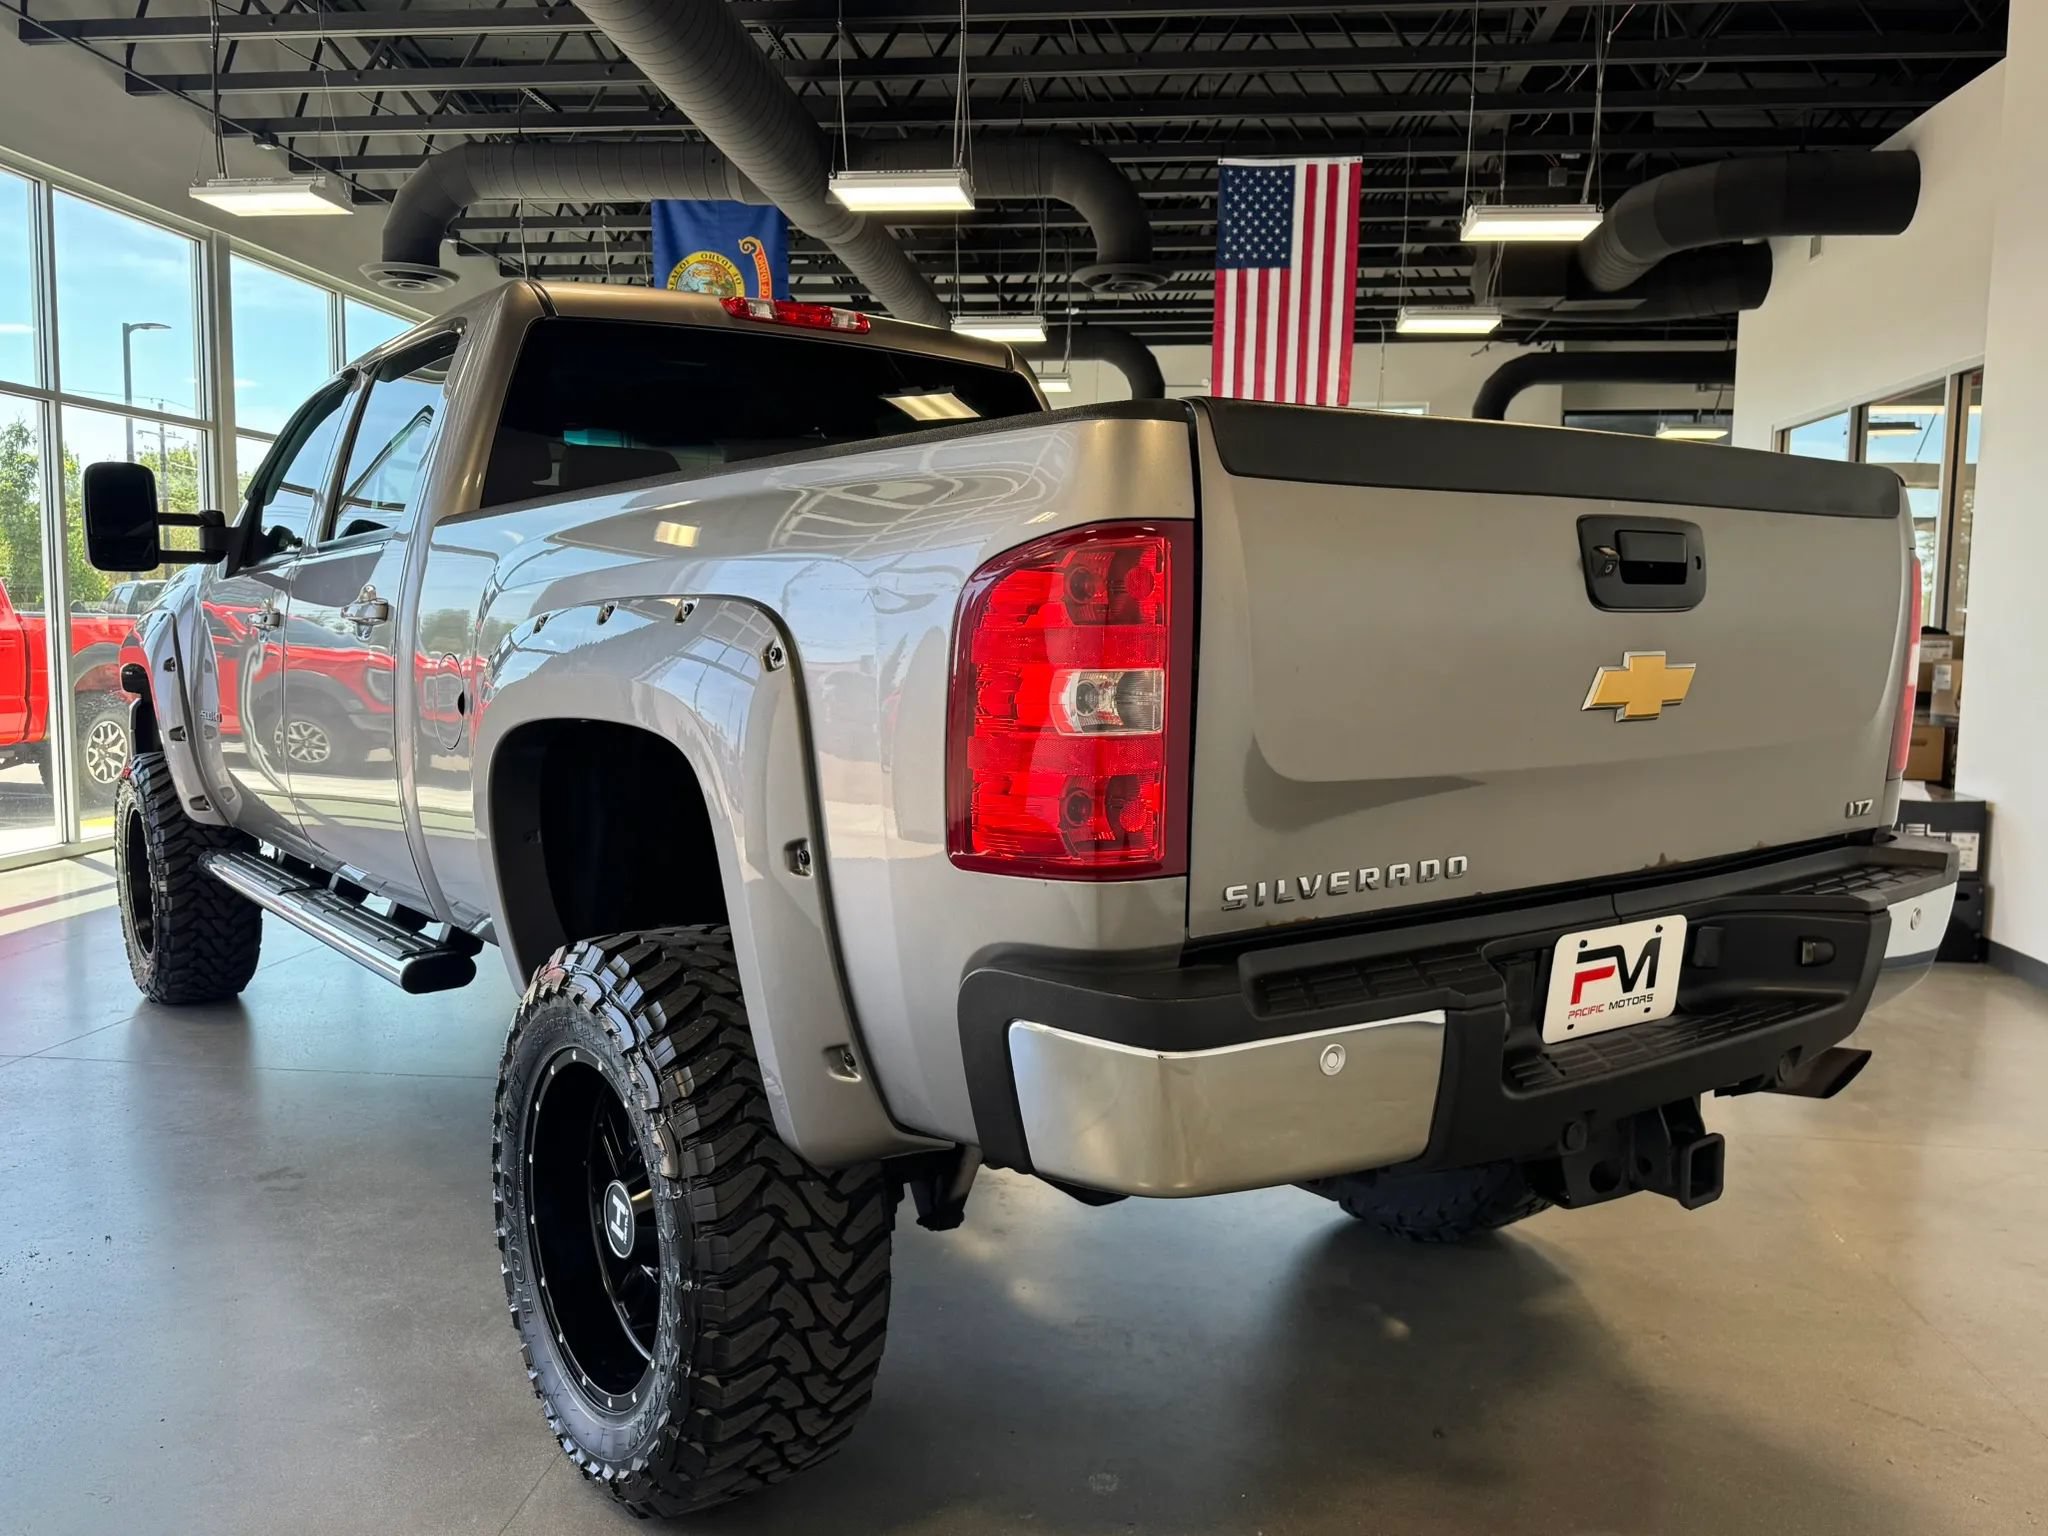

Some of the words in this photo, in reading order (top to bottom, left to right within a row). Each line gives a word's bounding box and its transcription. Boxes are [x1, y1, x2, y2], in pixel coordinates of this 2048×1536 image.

[1222, 856, 1468, 911] SILVERADO
[1567, 1003, 1605, 1020] PACIFIC
[1608, 993, 1654, 1010] MOTORS
